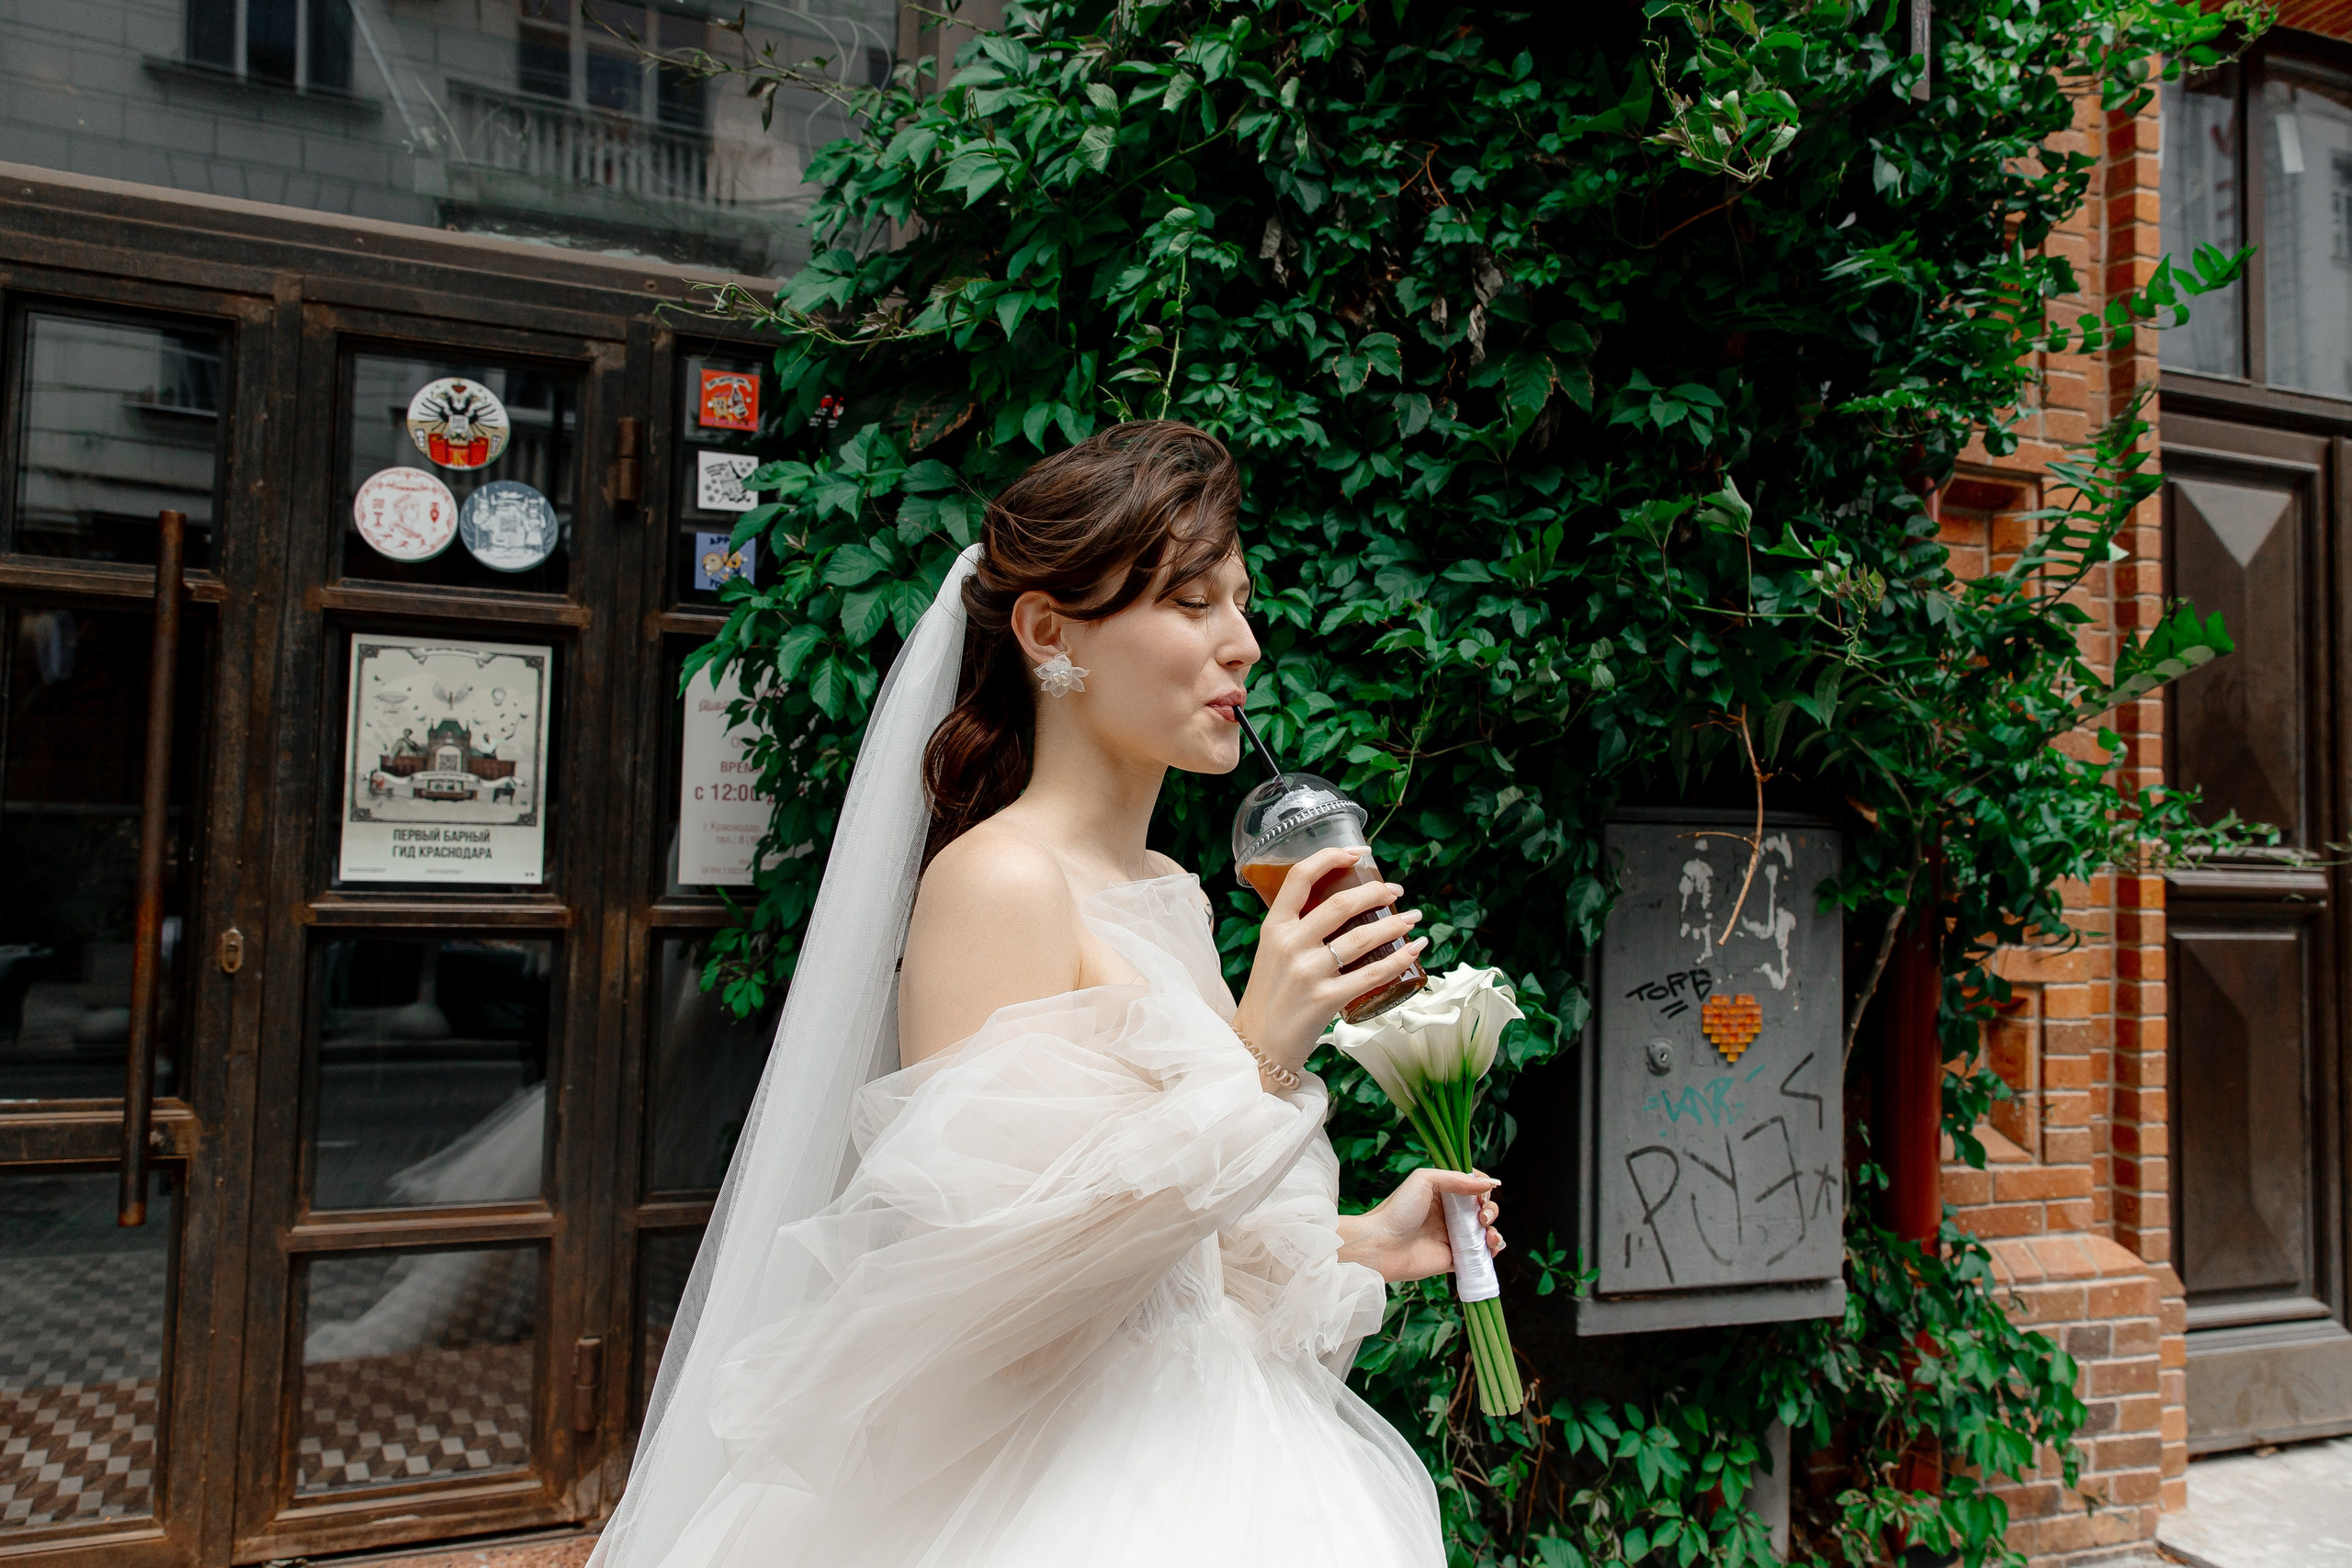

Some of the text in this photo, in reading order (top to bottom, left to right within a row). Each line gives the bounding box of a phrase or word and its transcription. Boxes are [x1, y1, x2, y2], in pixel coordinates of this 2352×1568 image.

[392, 827, 491, 843] ПЕРВЫЙ БАРНЫЙ
[392, 845, 492, 860] ГИД КРАСНОДАРА
